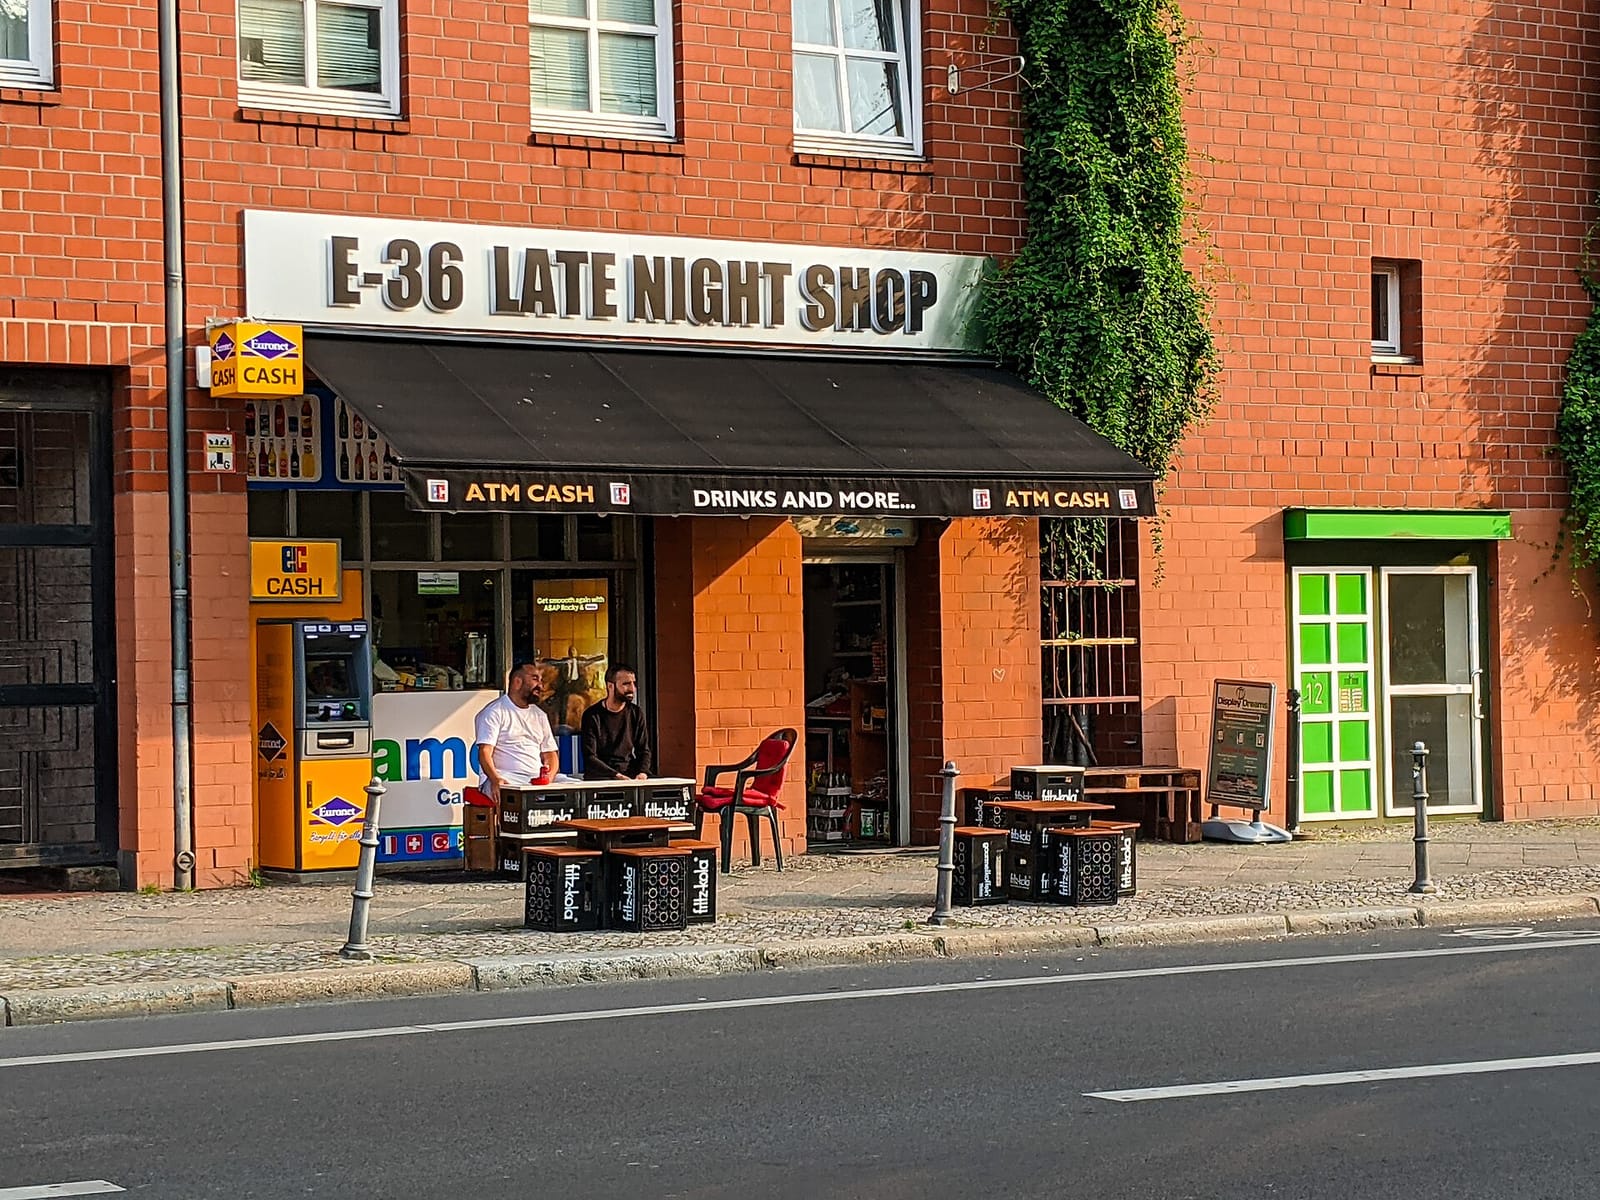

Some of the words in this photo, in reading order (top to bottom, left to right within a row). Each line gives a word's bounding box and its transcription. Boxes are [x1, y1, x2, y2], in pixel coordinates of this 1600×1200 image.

[329, 236, 463, 312] E-36
[491, 246, 617, 318] LATE
[627, 254, 792, 327] NIGHT
[801, 264, 937, 334] SHOP
[251, 338, 289, 351] Euronet
[212, 368, 235, 387] CASH
[243, 367, 296, 385] CASH
[210, 460, 217, 469] K
[223, 461, 230, 470] G
[465, 483, 521, 502] ATM
[527, 485, 595, 503] CASH
[693, 489, 777, 507] DRINKS
[782, 491, 833, 508] AND
[839, 492, 916, 509] MORE...
[1005, 491, 1049, 507] ATM
[1054, 492, 1110, 508] CASH
[267, 577, 322, 595] CASH
[1306, 682, 1323, 705] 12
[437, 788, 463, 805] Ca
[318, 807, 356, 817] Euronet
[1120, 836, 1132, 888] fritz-kola
[564, 864, 580, 923] fritz-kola
